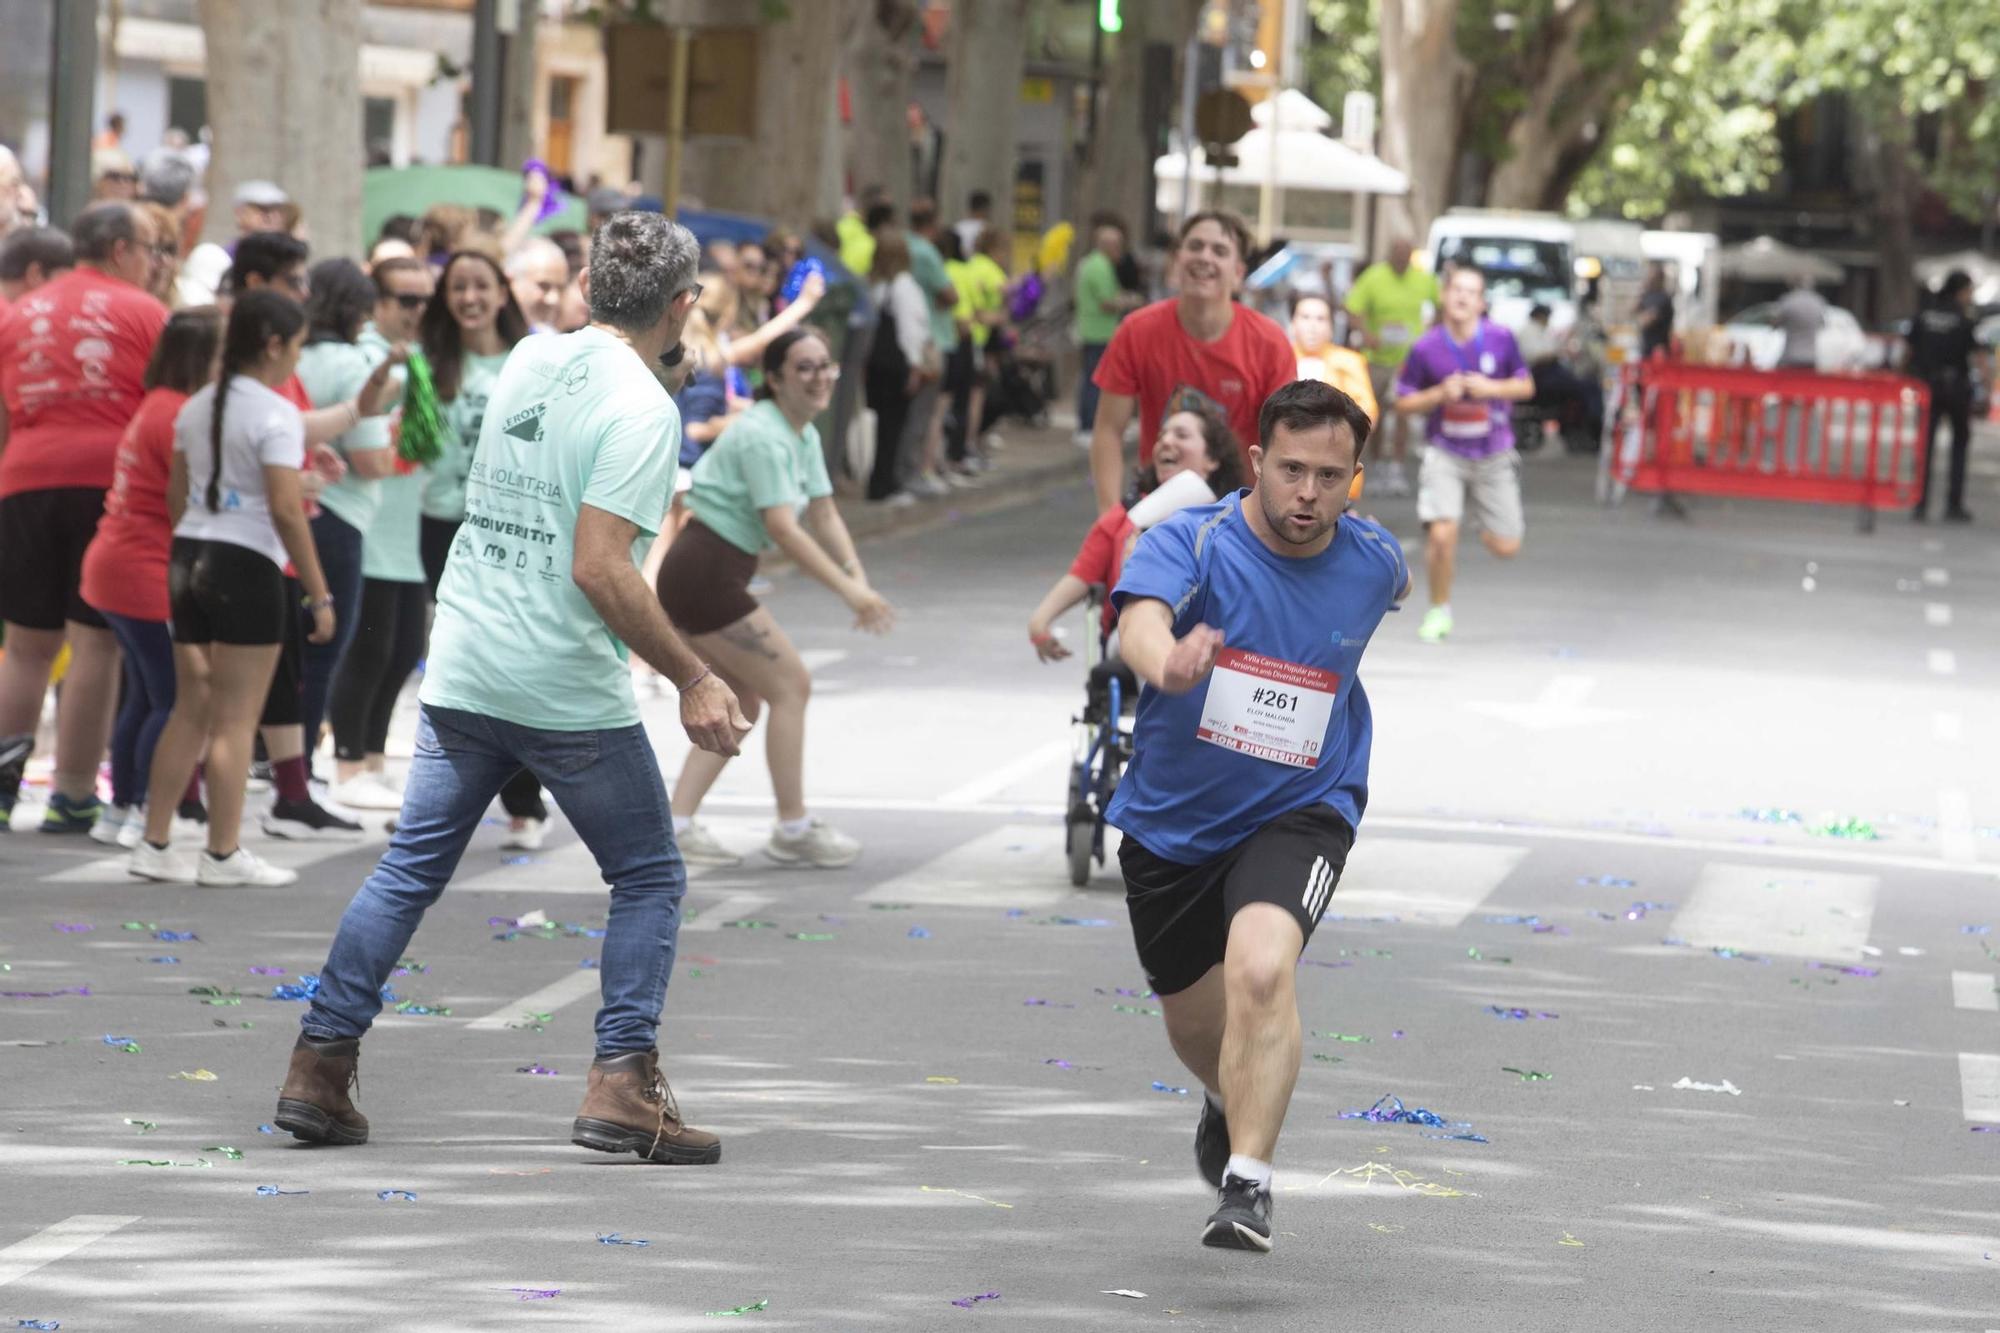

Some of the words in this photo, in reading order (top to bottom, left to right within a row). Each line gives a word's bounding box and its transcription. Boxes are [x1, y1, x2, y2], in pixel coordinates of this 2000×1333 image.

[1230, 659, 1259, 673] Persones
[1272, 670, 1302, 683] Diversitat
[1260, 657, 1284, 670] Carrera
[1284, 663, 1307, 675] Popular
[1307, 669, 1318, 678] per
[1252, 687, 1299, 712] #261
[1210, 732, 1238, 749] SOM
[1240, 740, 1309, 766] DIVERSITAT
